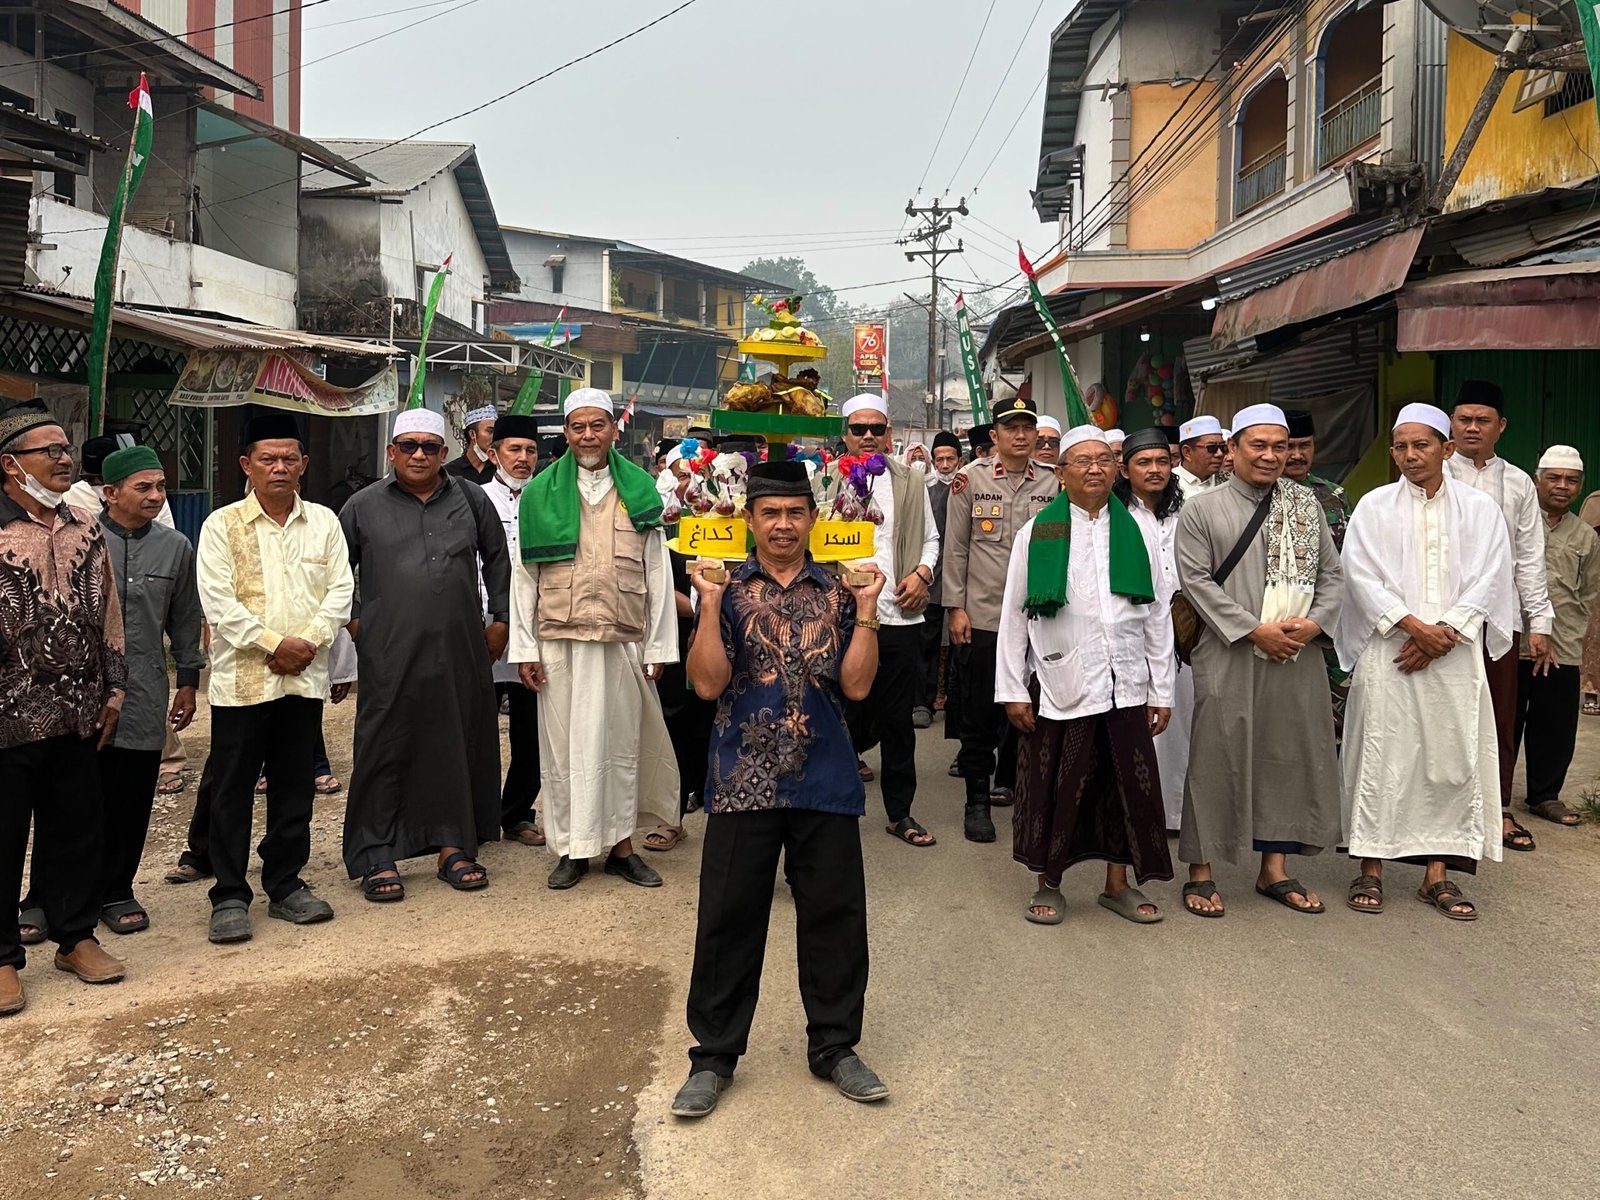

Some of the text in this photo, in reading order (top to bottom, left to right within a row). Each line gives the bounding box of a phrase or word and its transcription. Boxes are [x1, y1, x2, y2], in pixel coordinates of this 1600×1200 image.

[861, 332, 877, 351] 76
[958, 315, 986, 426] MUSLIM
[974, 493, 1003, 501] DADAN
